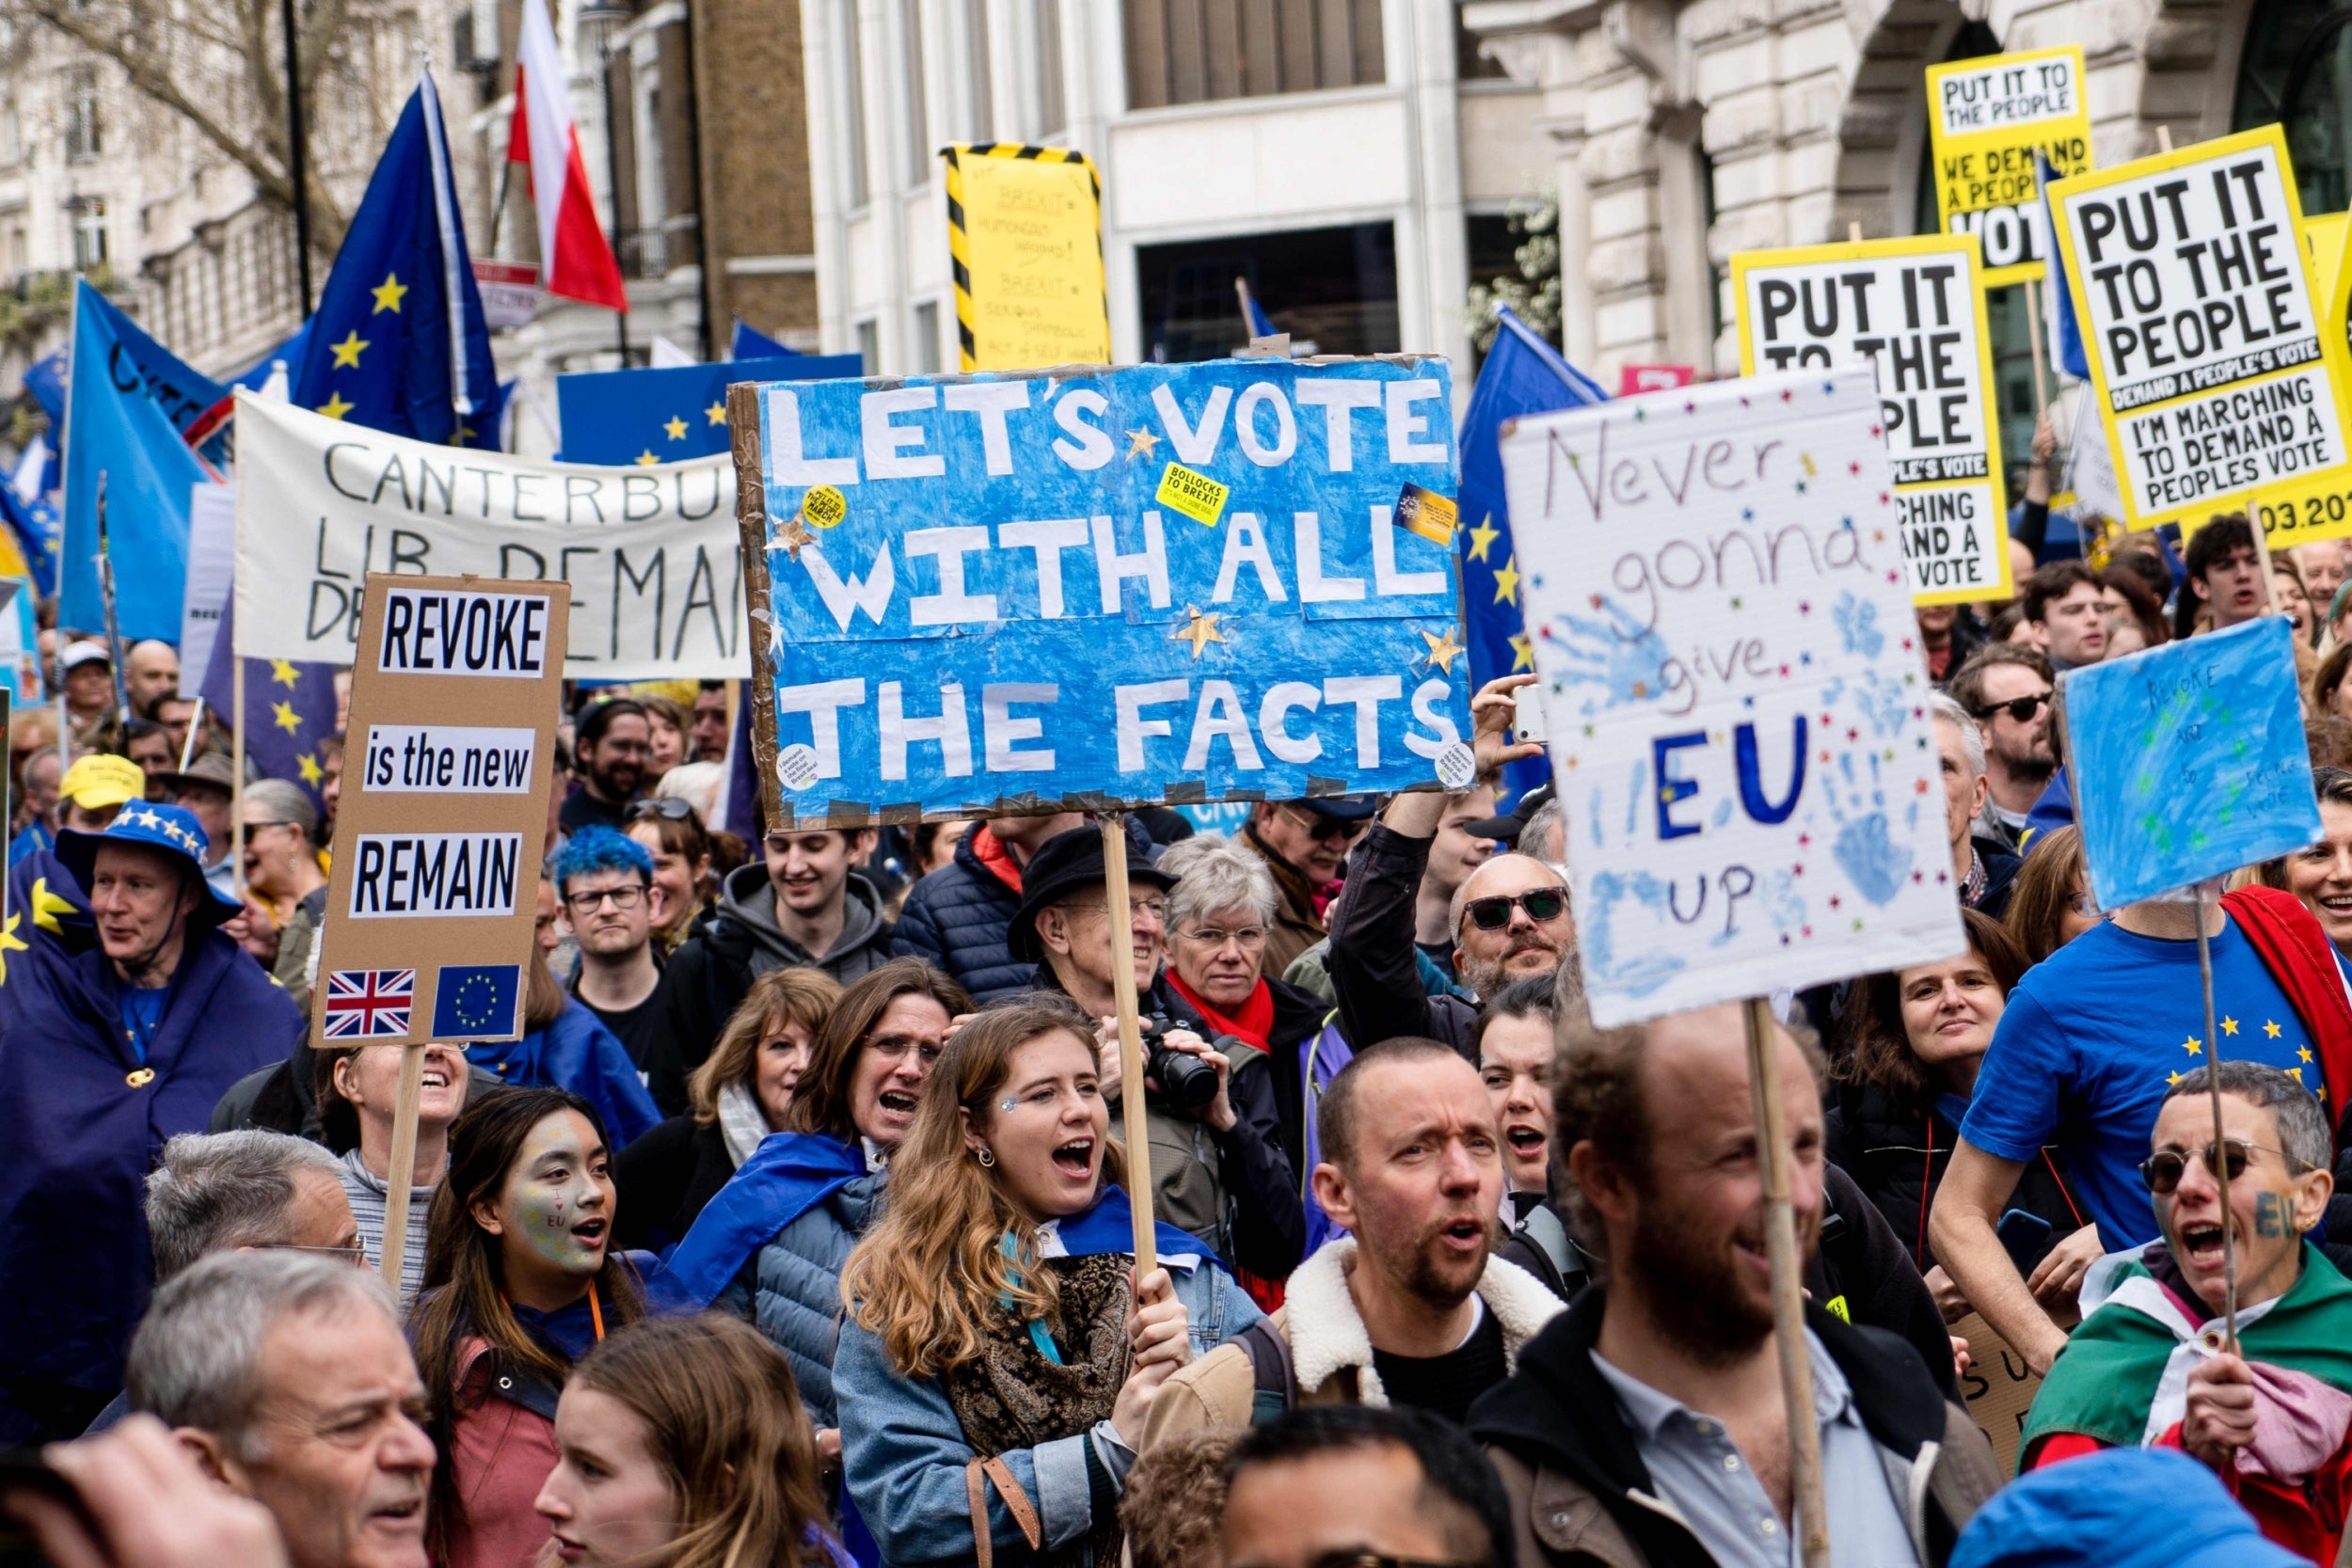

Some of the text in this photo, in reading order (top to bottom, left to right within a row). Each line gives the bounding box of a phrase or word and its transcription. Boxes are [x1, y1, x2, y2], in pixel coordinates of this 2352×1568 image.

[1944, 63, 2069, 105] PUT IT TO
[1947, 91, 2071, 128] THE PEOPLE
[998, 185, 1064, 213] BREXIT
[1944, 153, 1976, 181] WE
[1948, 187, 1961, 209] A
[2077, 160, 2265, 263] PUT IT
[1758, 265, 1955, 341] PUT IT
[2092, 224, 2288, 321] TO THE
[2106, 283, 2302, 375] PEOPLE
[2111, 338, 2320, 410] DEMAND A PEOPLE'S VOTE
[768, 377, 1448, 486] LET'S VOTE
[2132, 377, 2313, 448] I'M MARCHING
[2138, 407, 2323, 478] TO DEMAND A
[325, 442, 739, 524] CANTERBU
[1166, 475, 1217, 506] TO BREXIT
[1170, 467, 1221, 496] BOLLOCKS
[1543, 419, 1783, 522] Never
[1942, 454, 1987, 478] VOTE
[2146, 438, 2329, 508] PEOPLES VOTE
[807, 502, 833, 521] MARCH
[1964, 524, 1979, 552] A
[2259, 491, 2352, 533] 03.20
[317, 516, 431, 582] LIB
[800, 504, 1448, 634] WITH ALL
[1612, 523, 1873, 644] gonna
[1917, 557, 1982, 587] VOTE
[382, 595, 545, 671] REVOKE
[1659, 637, 1772, 717] give
[2146, 664, 2220, 715] REVOKE
[366, 731, 530, 788] is the new
[779, 674, 1461, 781] THE FACTS
[1653, 712, 1808, 840] EU
[355, 838, 517, 912] REMAIN
[547, 1214, 566, 1227] EU
[552, 1188, 564, 1200] I
